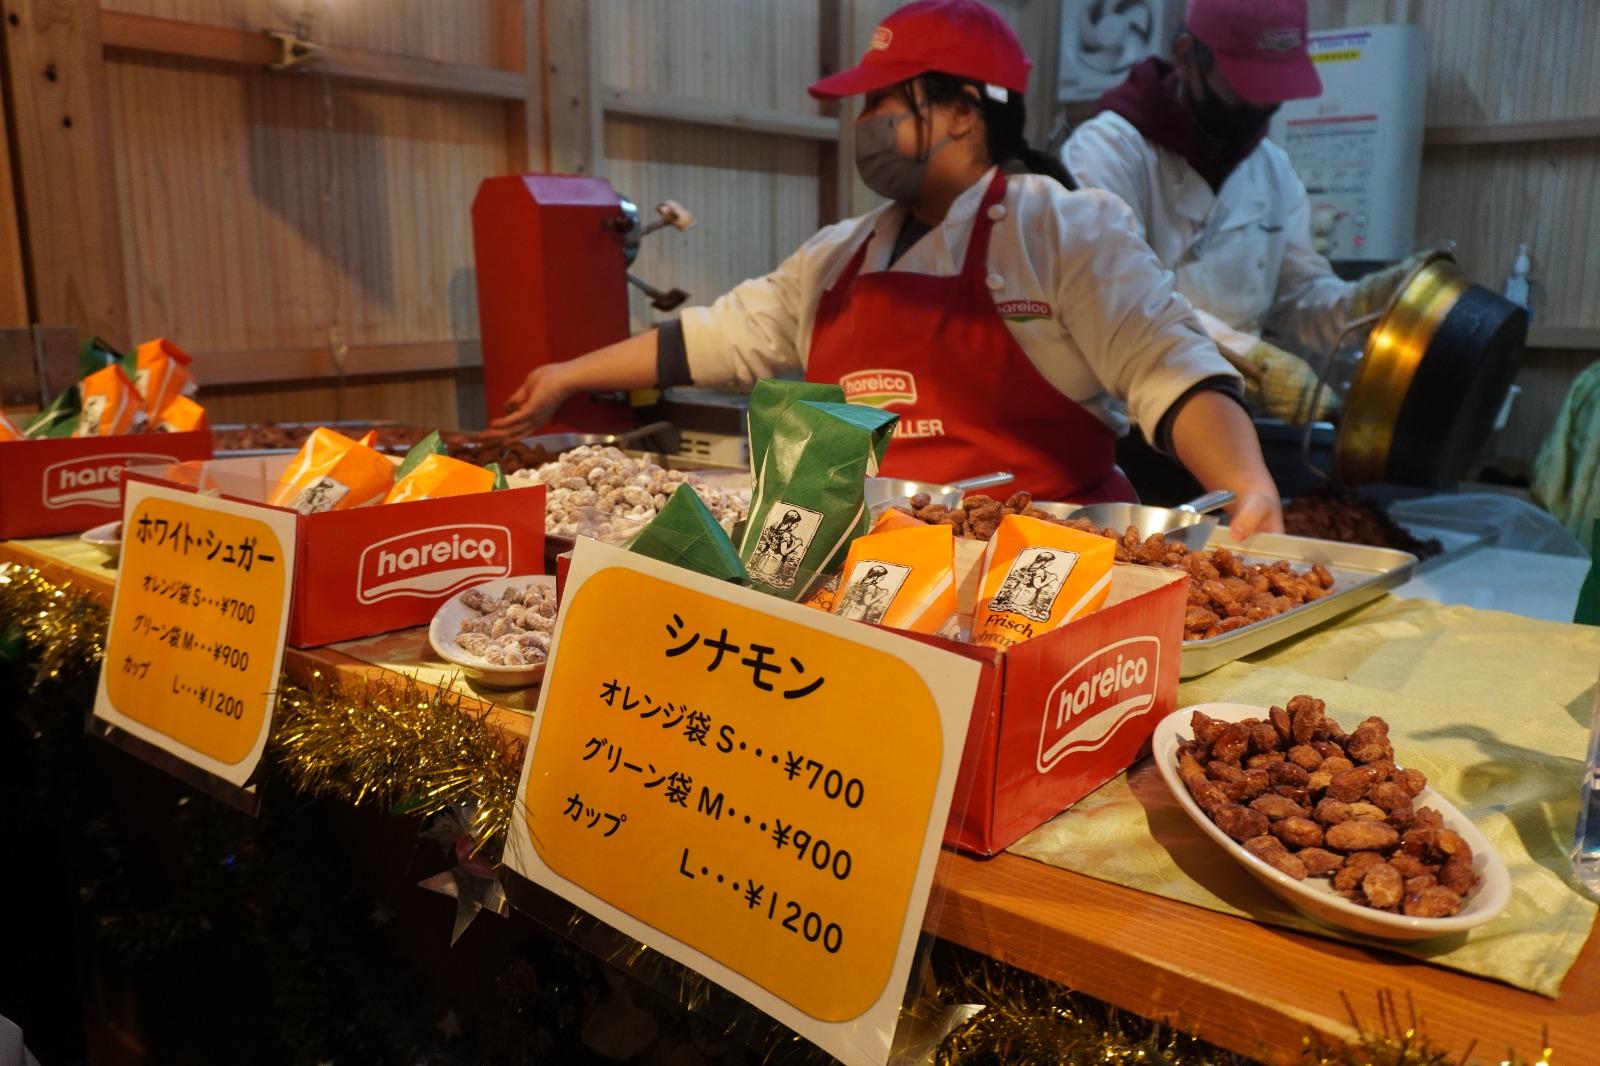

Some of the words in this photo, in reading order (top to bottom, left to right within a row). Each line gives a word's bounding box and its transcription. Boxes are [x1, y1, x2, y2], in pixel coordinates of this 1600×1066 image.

[846, 374, 907, 394] hareico
[59, 464, 122, 491] hare
[136, 514, 275, 571] ホワイト・シュガー
[377, 533, 496, 577] hareico
[142, 575, 192, 606] オレンジ袋
[132, 614, 182, 649] グリーン袋
[984, 614, 1034, 638] Frisch
[122, 655, 151, 680] カップ
[665, 614, 825, 699] シナモン
[599, 679, 712, 747] オレンジ袋
[1056, 653, 1147, 730] hareico
[582, 737, 693, 808] グリーン袋
[563, 793, 627, 838] カップ
